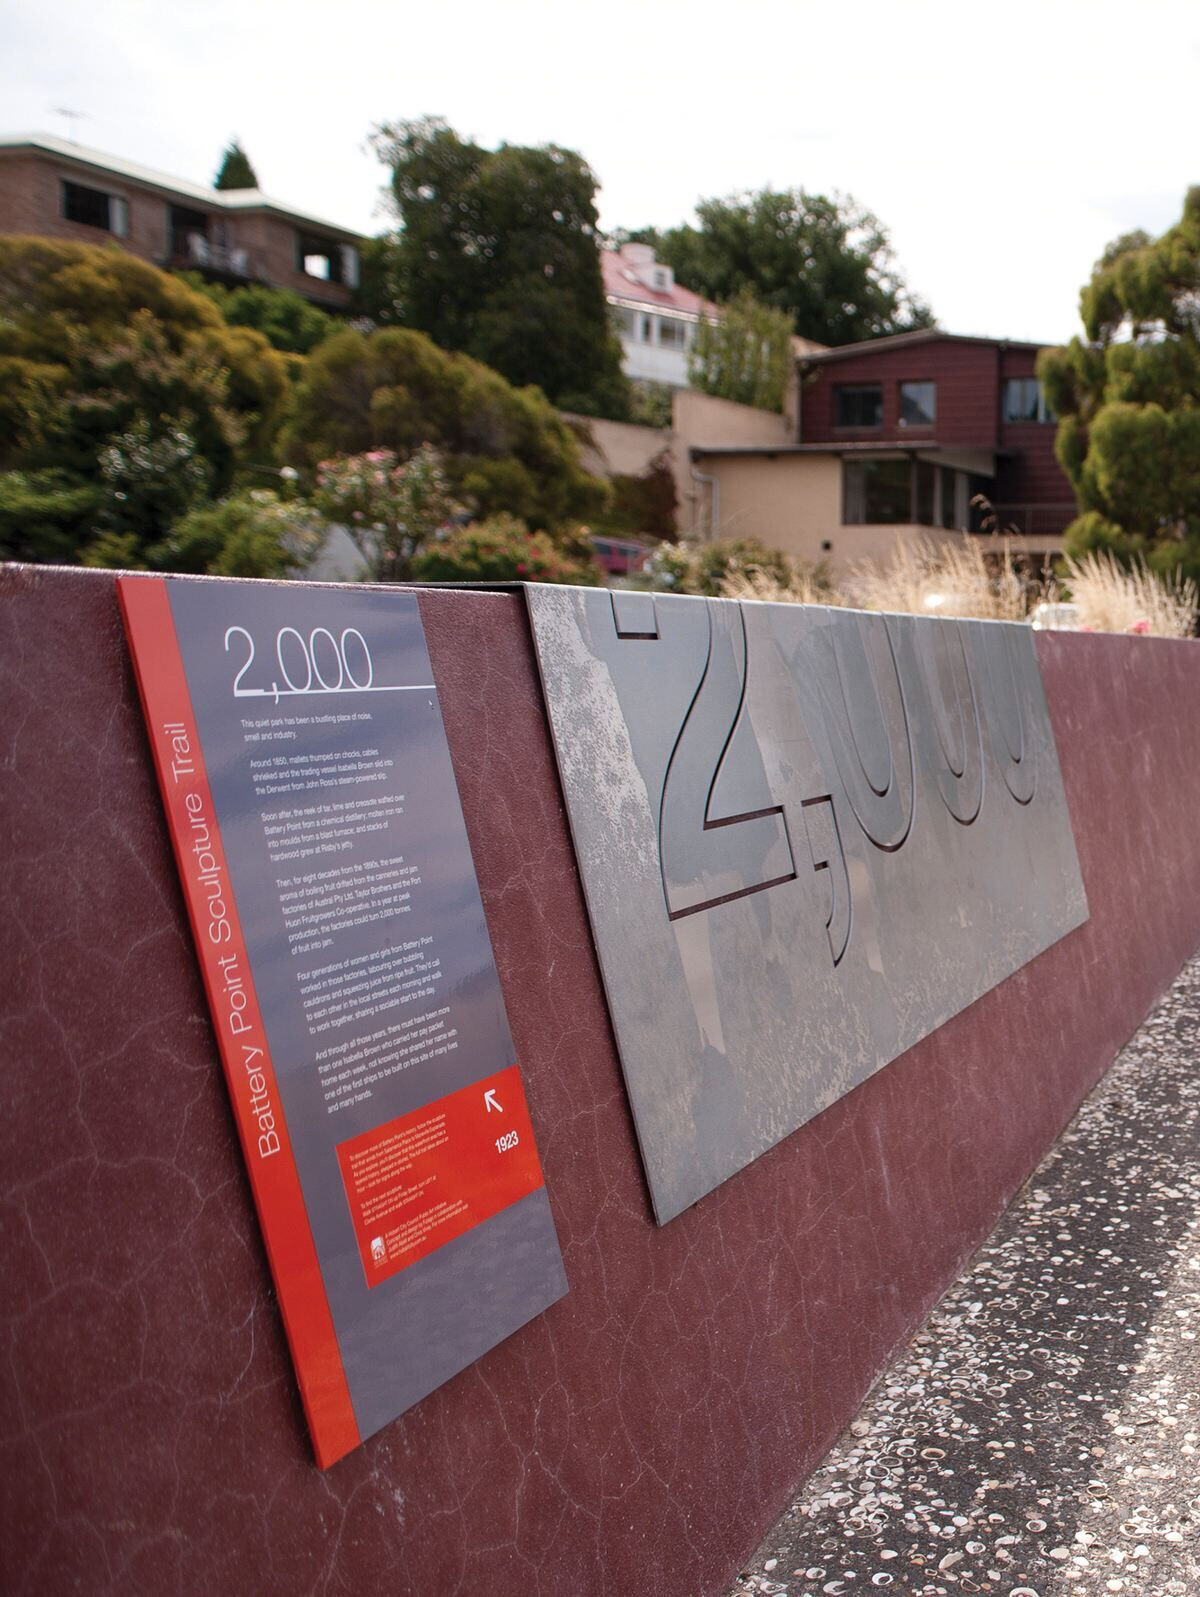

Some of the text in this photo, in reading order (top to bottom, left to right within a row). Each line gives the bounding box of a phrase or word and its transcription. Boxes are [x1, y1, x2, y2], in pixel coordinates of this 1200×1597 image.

[225, 626, 372, 704] 2,000
[241, 719, 254, 728] This
[271, 719, 283, 727] park
[315, 715, 336, 723] bustling
[244, 733, 260, 741] smell
[250, 759, 271, 768] Around
[309, 753, 333, 761] thumped
[253, 772, 277, 781] shrieked
[300, 768, 320, 776] trading
[321, 765, 337, 773] vessel
[338, 763, 357, 771] Isabella
[255, 787, 265, 795] the
[266, 784, 290, 793] Derwent
[306, 781, 319, 789] John
[339, 774, 377, 784] steam-powered
[261, 813, 277, 821] Soon
[304, 807, 316, 815] reek
[345, 801, 355, 809] and
[264, 826, 285, 835] Battery
[286, 822, 301, 831] Point
[321, 816, 344, 825] chemical
[270, 850, 299, 861] hardwood
[300, 849, 314, 858] grew
[293, 876, 301, 884] for
[303, 873, 316, 883] eight
[318, 870, 340, 879] decades
[354, 864, 362, 872] the
[389, 856, 403, 864] sweet
[282, 904, 307, 914] factories
[315, 897, 333, 906] Austral
[334, 895, 343, 903] Pty
[355, 889, 370, 897] Taylor
[371, 885, 392, 894] Brothers
[393, 881, 402, 889] and
[285, 919, 301, 928] Huon
[302, 911, 335, 923] Fruitgrowers
[382, 897, 392, 906] year
[399, 892, 410, 901] peak
[331, 920, 353, 930] factories
[354, 915, 368, 924] could
[369, 913, 379, 921] turn
[394, 905, 411, 914] tonnes
[163, 722, 280, 1158] Battery Point Sculpture Trail
[297, 972, 310, 981] Four
[312, 963, 343, 978] generations
[350, 955, 369, 965] women
[370, 951, 380, 960] and
[380, 949, 391, 959] girls
[391, 945, 403, 953] from
[403, 941, 420, 950] Battery
[420, 936, 433, 944] Point
[304, 994, 330, 1008] cauldrons
[332, 990, 342, 999] and
[343, 982, 369, 995] squeezing
[370, 978, 381, 988] juice
[382, 974, 394, 982] from
[394, 971, 404, 979] ripe
[432, 958, 440, 967] call
[317, 1022, 330, 1031] work
[355, 1008, 374, 1019] sharing
[379, 999, 399, 1010] sociable
[400, 994, 412, 1003] start
[316, 1050, 327, 1060] And
[328, 1043, 349, 1055] through
[356, 1035, 371, 1045] those
[388, 1025, 400, 1033] there
[401, 1019, 414, 1028] must
[426, 1011, 437, 1020] been
[438, 1007, 450, 1015] more
[318, 1064, 331, 1073] than
[332, 1060, 342, 1068] one
[343, 1052, 363, 1064] Isabella
[364, 1045, 381, 1056] Brown
[381, 1041, 392, 1049] who
[393, 1033, 410, 1045] carried
[419, 1028, 428, 1036] pay
[429, 1021, 444, 1032] packet
[328, 1103, 339, 1113] and
[339, 1098, 354, 1108] many
[495, 1130, 519, 1154] 1923
